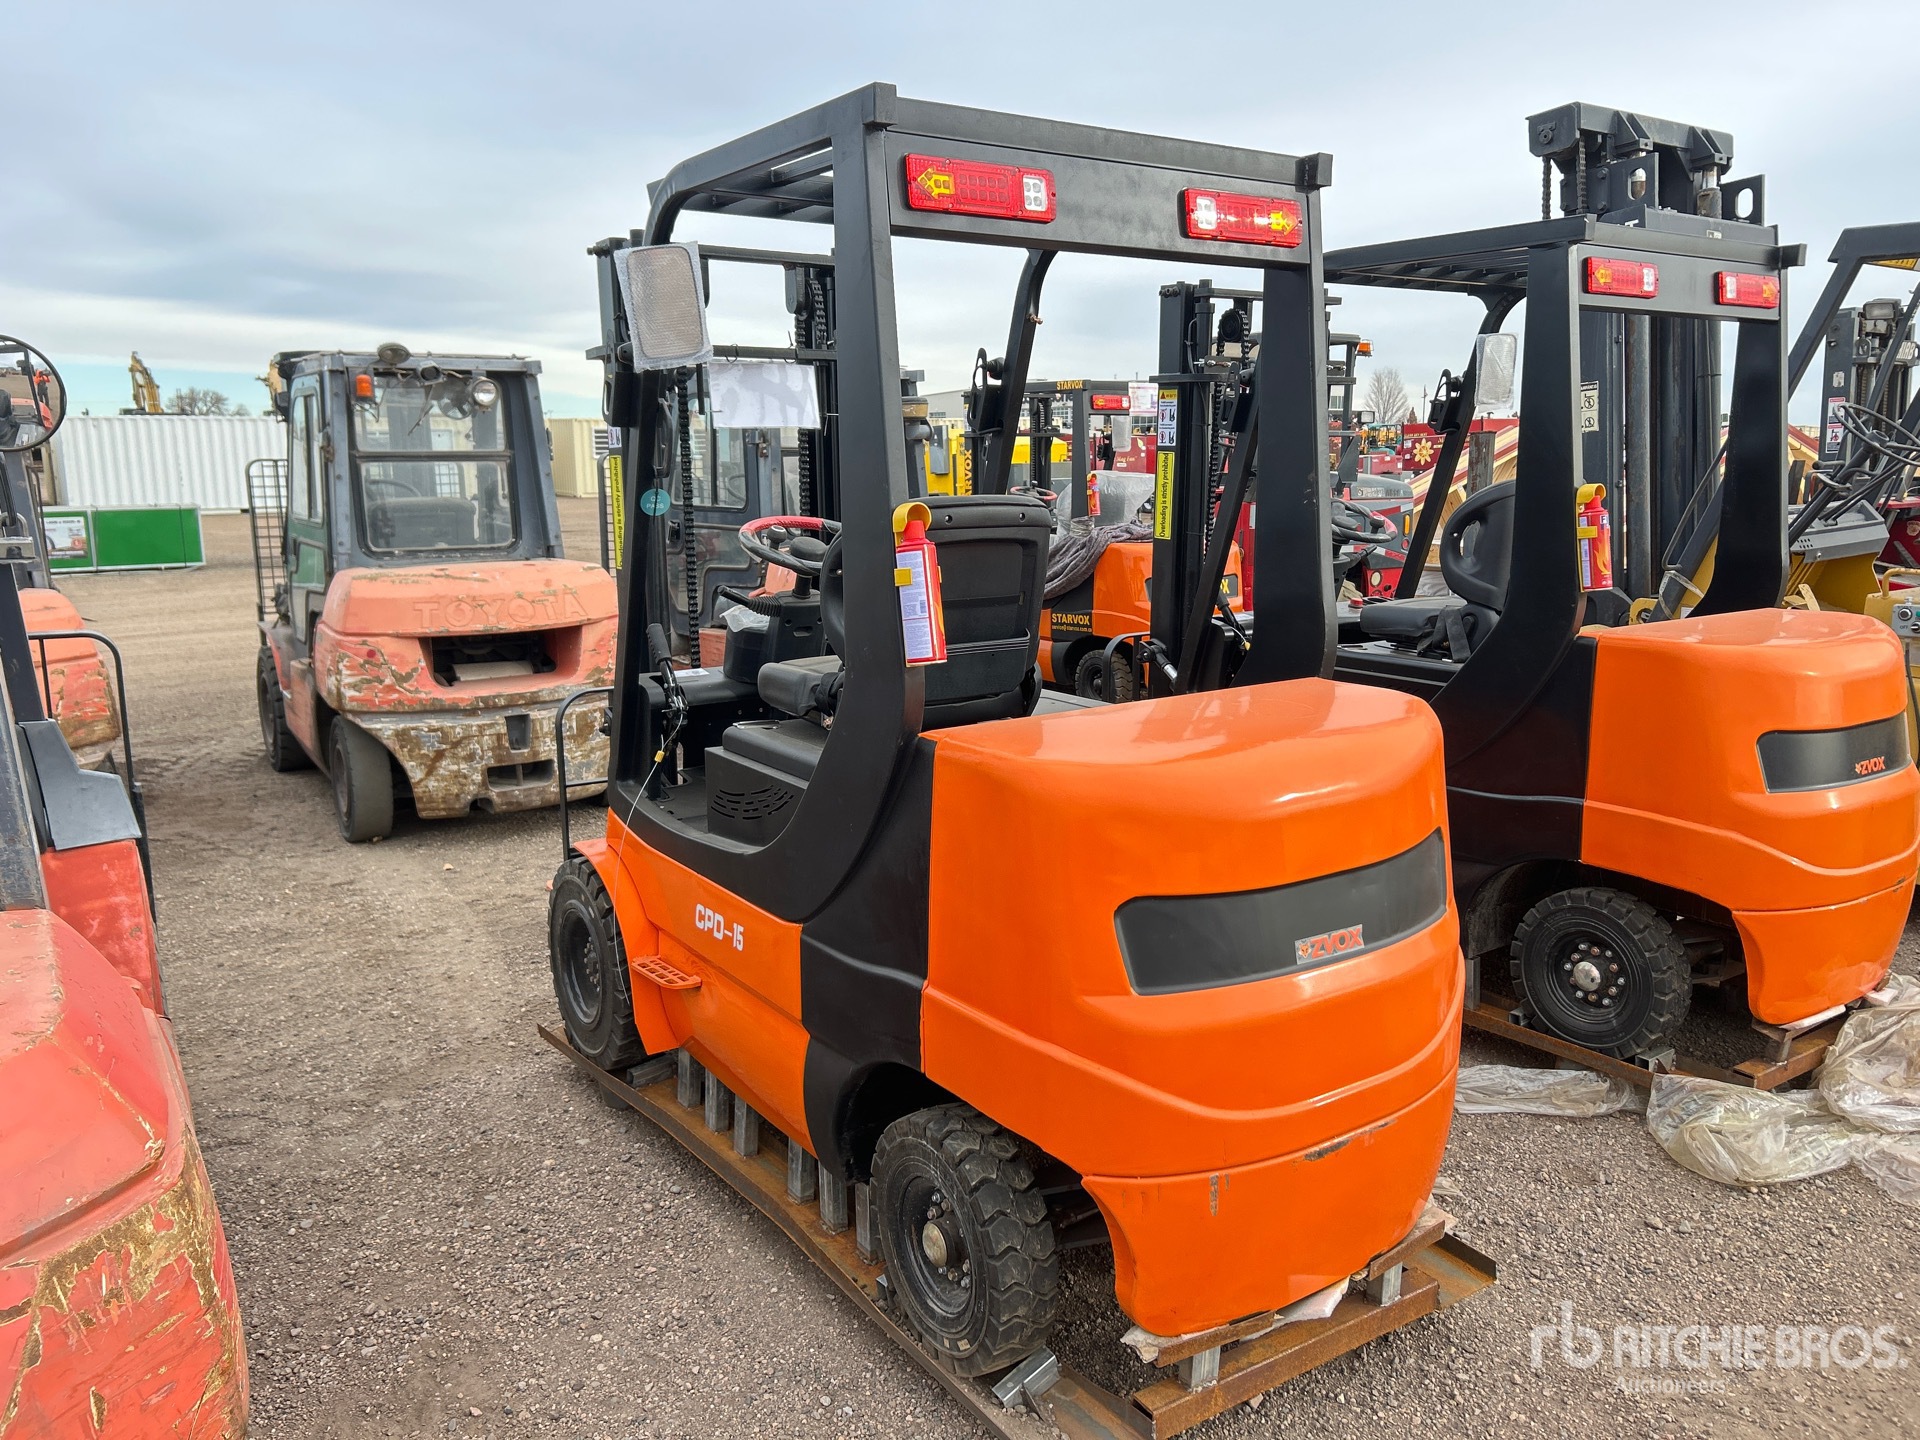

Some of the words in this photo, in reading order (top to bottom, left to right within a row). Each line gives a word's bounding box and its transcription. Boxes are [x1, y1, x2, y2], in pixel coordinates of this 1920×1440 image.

[1056, 380, 1083, 390] STARVOX
[613, 457, 621, 493] prohibited
[1161, 453, 1170, 480] prohibited
[1161, 480, 1169, 499] strictly
[1159, 505, 1168, 538] Overloading
[413, 592, 588, 628] TOYOTA
[1052, 613, 1090, 625] STARVOX
[695, 903, 744, 951] CPD-15
[1311, 928, 1362, 958] ZVOX
